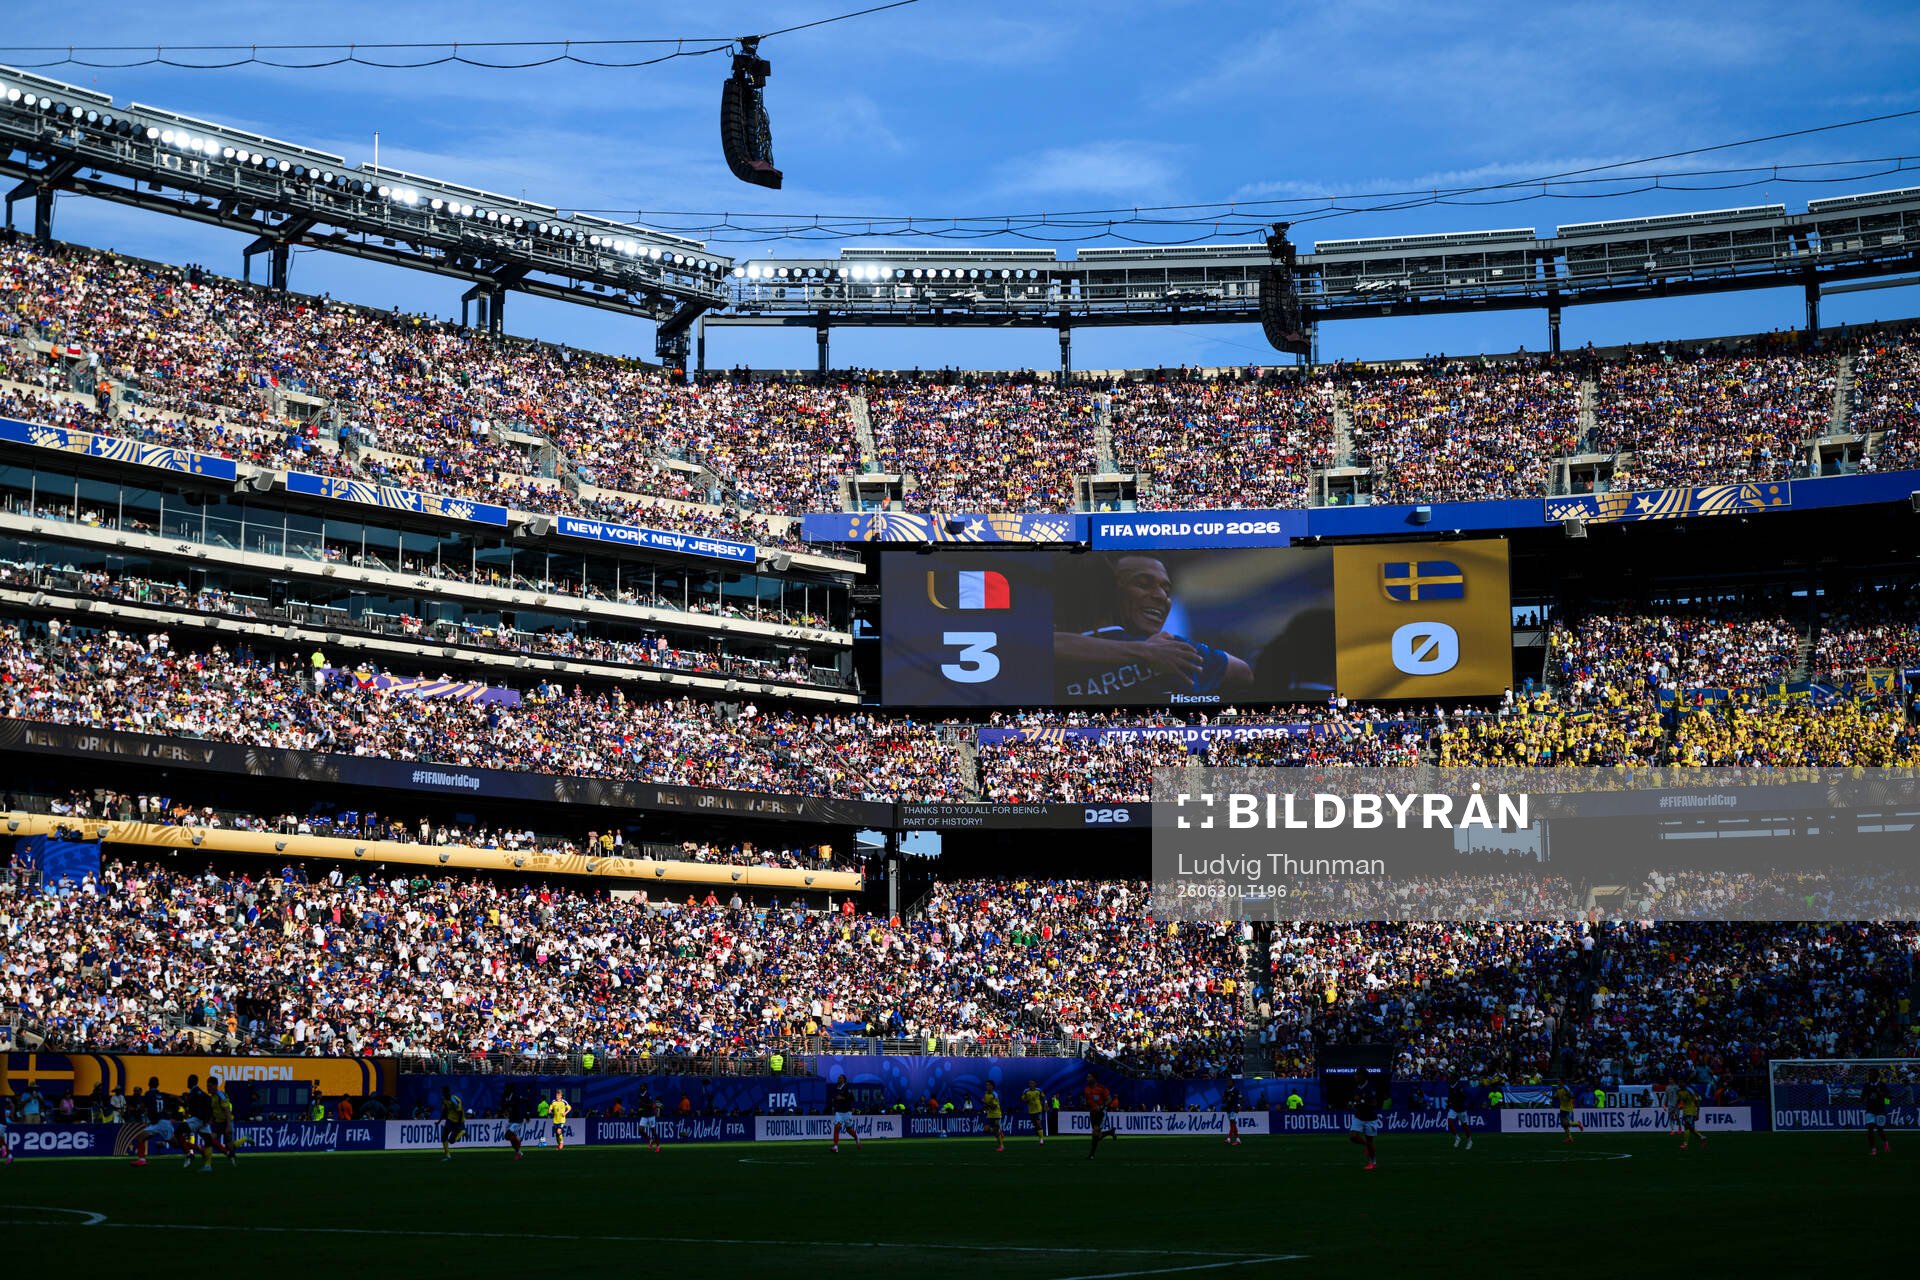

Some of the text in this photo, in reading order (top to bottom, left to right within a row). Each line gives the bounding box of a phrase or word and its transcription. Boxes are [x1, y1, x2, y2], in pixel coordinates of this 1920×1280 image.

[1101, 521, 1281, 537] FIFA WORLD CUP 2026
[566, 521, 747, 557] NEW YORK NEW JERSEY
[940, 631, 1000, 684] 3
[1170, 693, 1221, 703] Hisense
[1107, 730, 1138, 742] FIFA
[1142, 729, 1199, 742] WORLD
[1200, 729, 1232, 742] CUP
[114, 740, 150, 757] NW
[412, 769, 480, 790] #FIFAWorldCup
[726, 796, 754, 811] NW
[1659, 794, 1737, 808] #FIFAWorldCup
[903, 806, 1048, 815] THANKS TO YOU ALL FOR BEING A
[903, 818, 983, 826] PART OF HISTORY!
[209, 1064, 293, 1085] SWEDEN
[768, 1092, 798, 1108] FIFA
[946, 1117, 970, 1133] UNITES
[1071, 1113, 1256, 1132] FOOALL UNITES the World IFA
[1284, 1113, 1340, 1130] FOOTBALL
[1387, 1111, 1408, 1130] the
[1410, 1110, 1448, 1131] World
[1518, 1111, 1561, 1129] FOOTBA
[1582, 1111, 1624, 1129] UNITES
[1628, 1110, 1652, 1129] the
[1705, 1113, 1734, 1125] FIFA
[1777, 1109, 1835, 1127] OOTBALL
[1838, 1108, 1866, 1127] UNIT
[276, 1121, 299, 1149] the
[300, 1122, 338, 1149] World
[346, 1128, 371, 1142] FIFA
[400, 1123, 444, 1145] FOOTBA
[460, 1122, 490, 1143] NITES
[492, 1120, 507, 1144] th
[551, 1124, 574, 1137] FFA
[597, 1121, 642, 1141] FOOTBALL
[692, 1118, 722, 1141] World
[726, 1124, 745, 1136] FIFA
[766, 1120, 804, 1136] FOOTBALL
[806, 1119, 832, 1136] UNITES
[876, 1121, 893, 1132] FIFA
[23, 1131, 90, 1151] 2026
